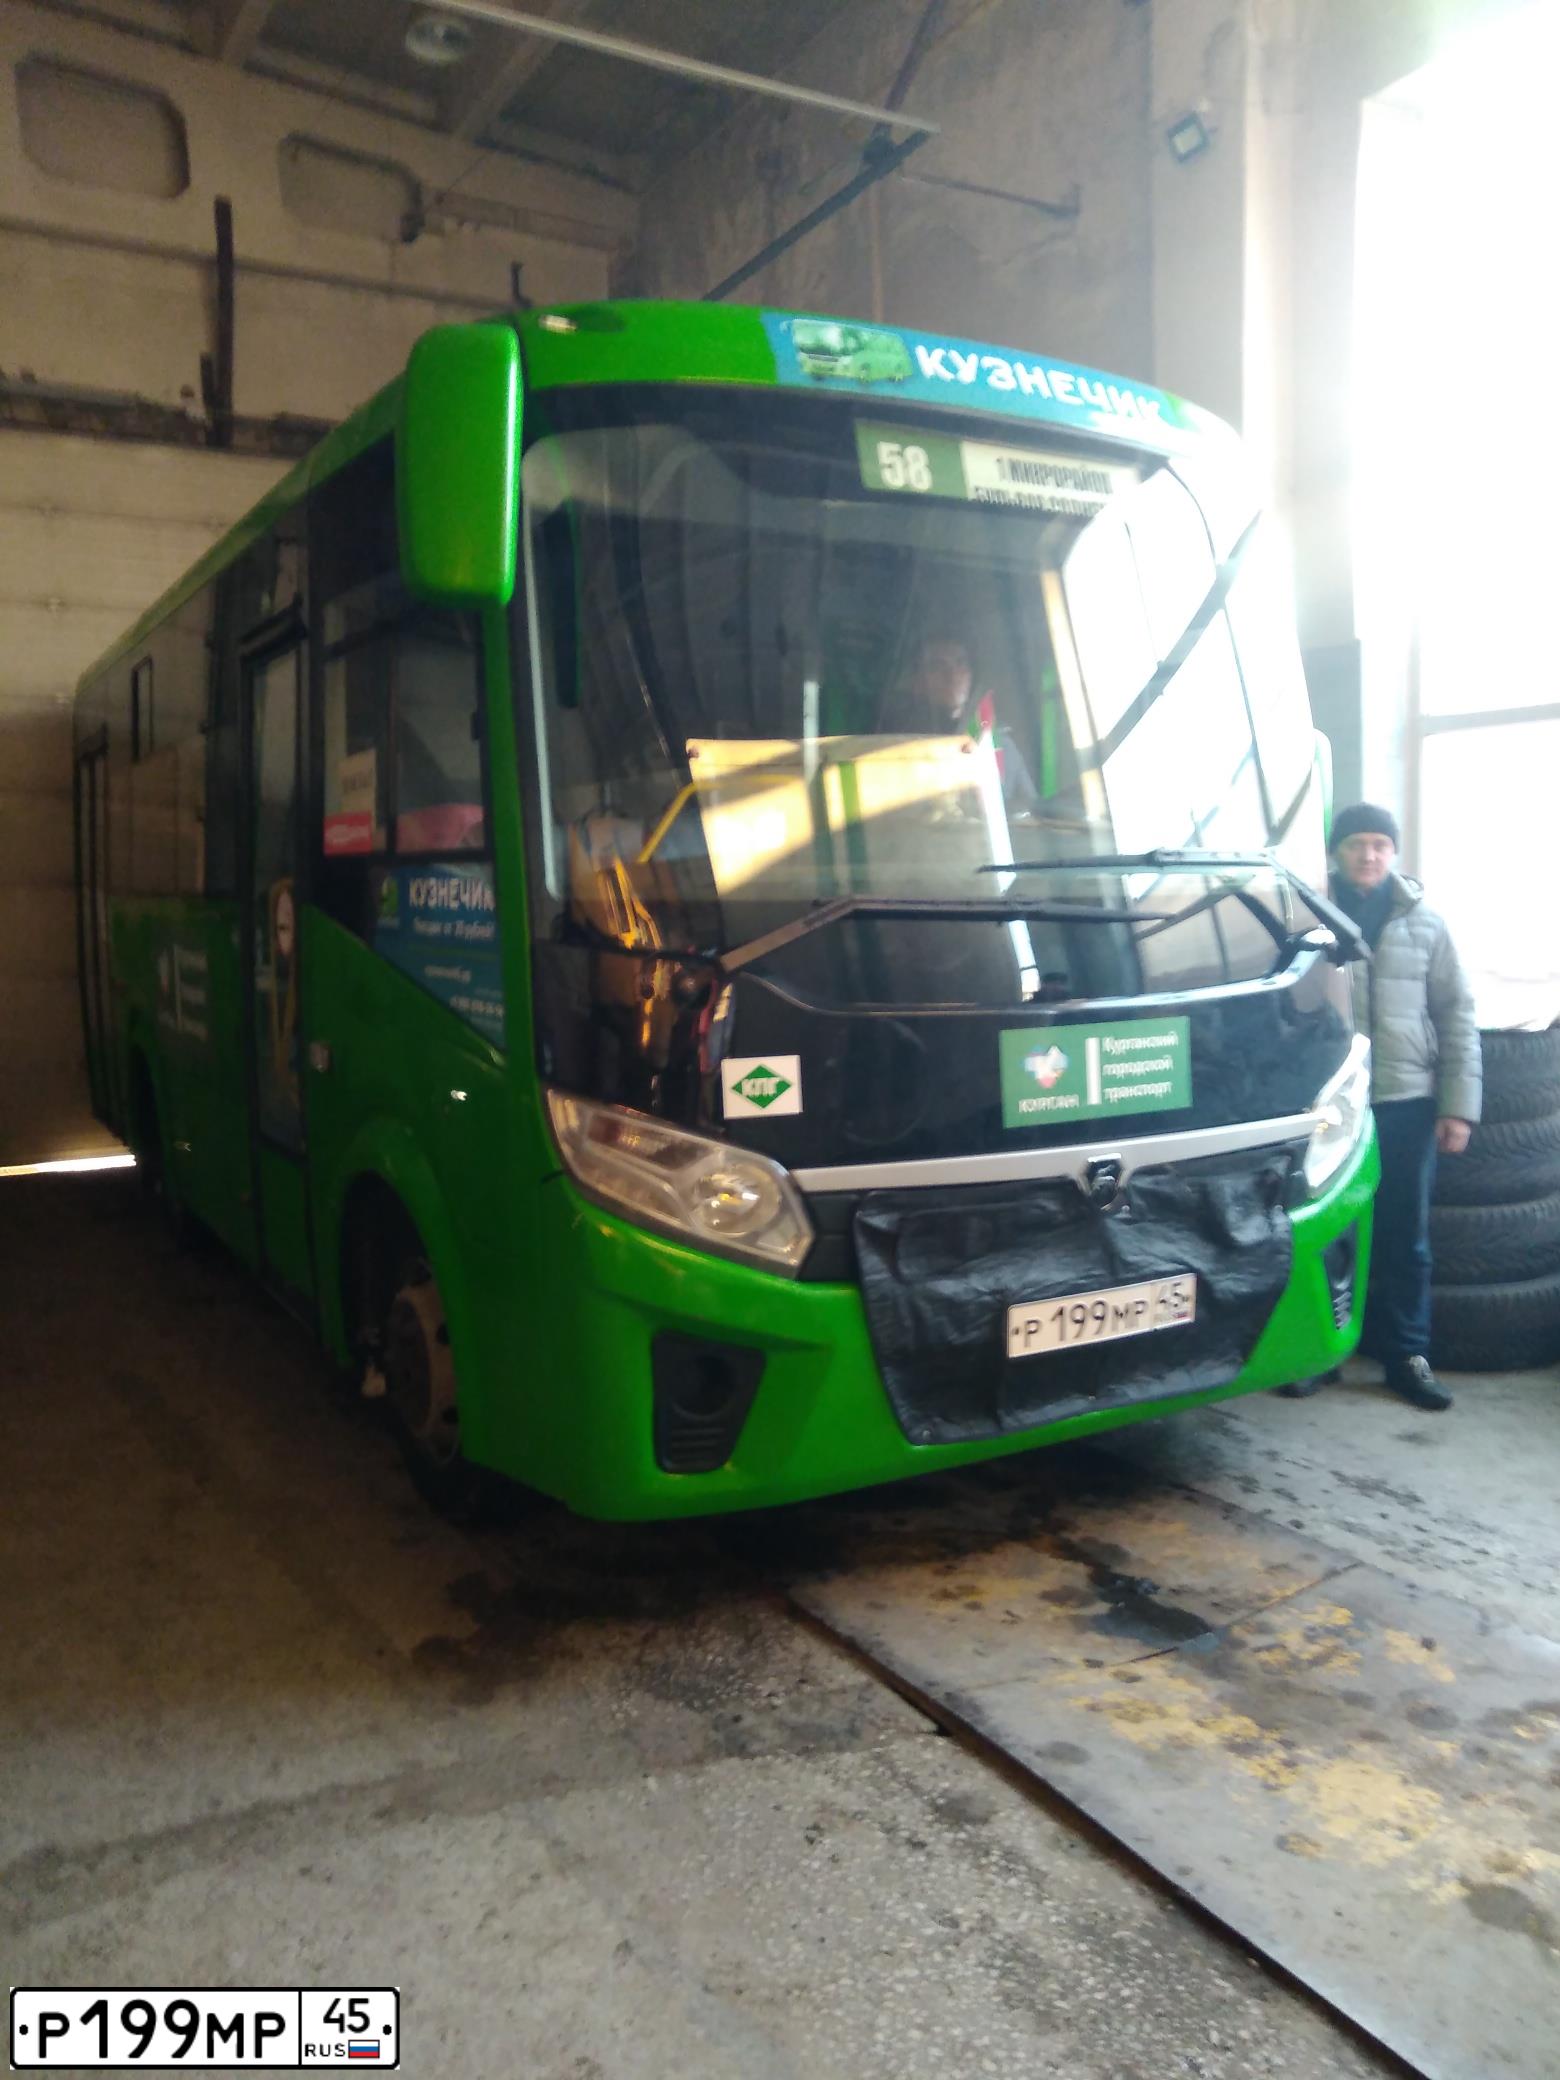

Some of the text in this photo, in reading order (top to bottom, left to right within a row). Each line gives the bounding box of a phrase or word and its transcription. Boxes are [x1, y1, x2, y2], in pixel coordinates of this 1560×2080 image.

[914, 344, 1166, 420] КУЗНЕЧИК
[876, 440, 933, 491] 58
[1103, 1081, 1173, 1103] транспорт
